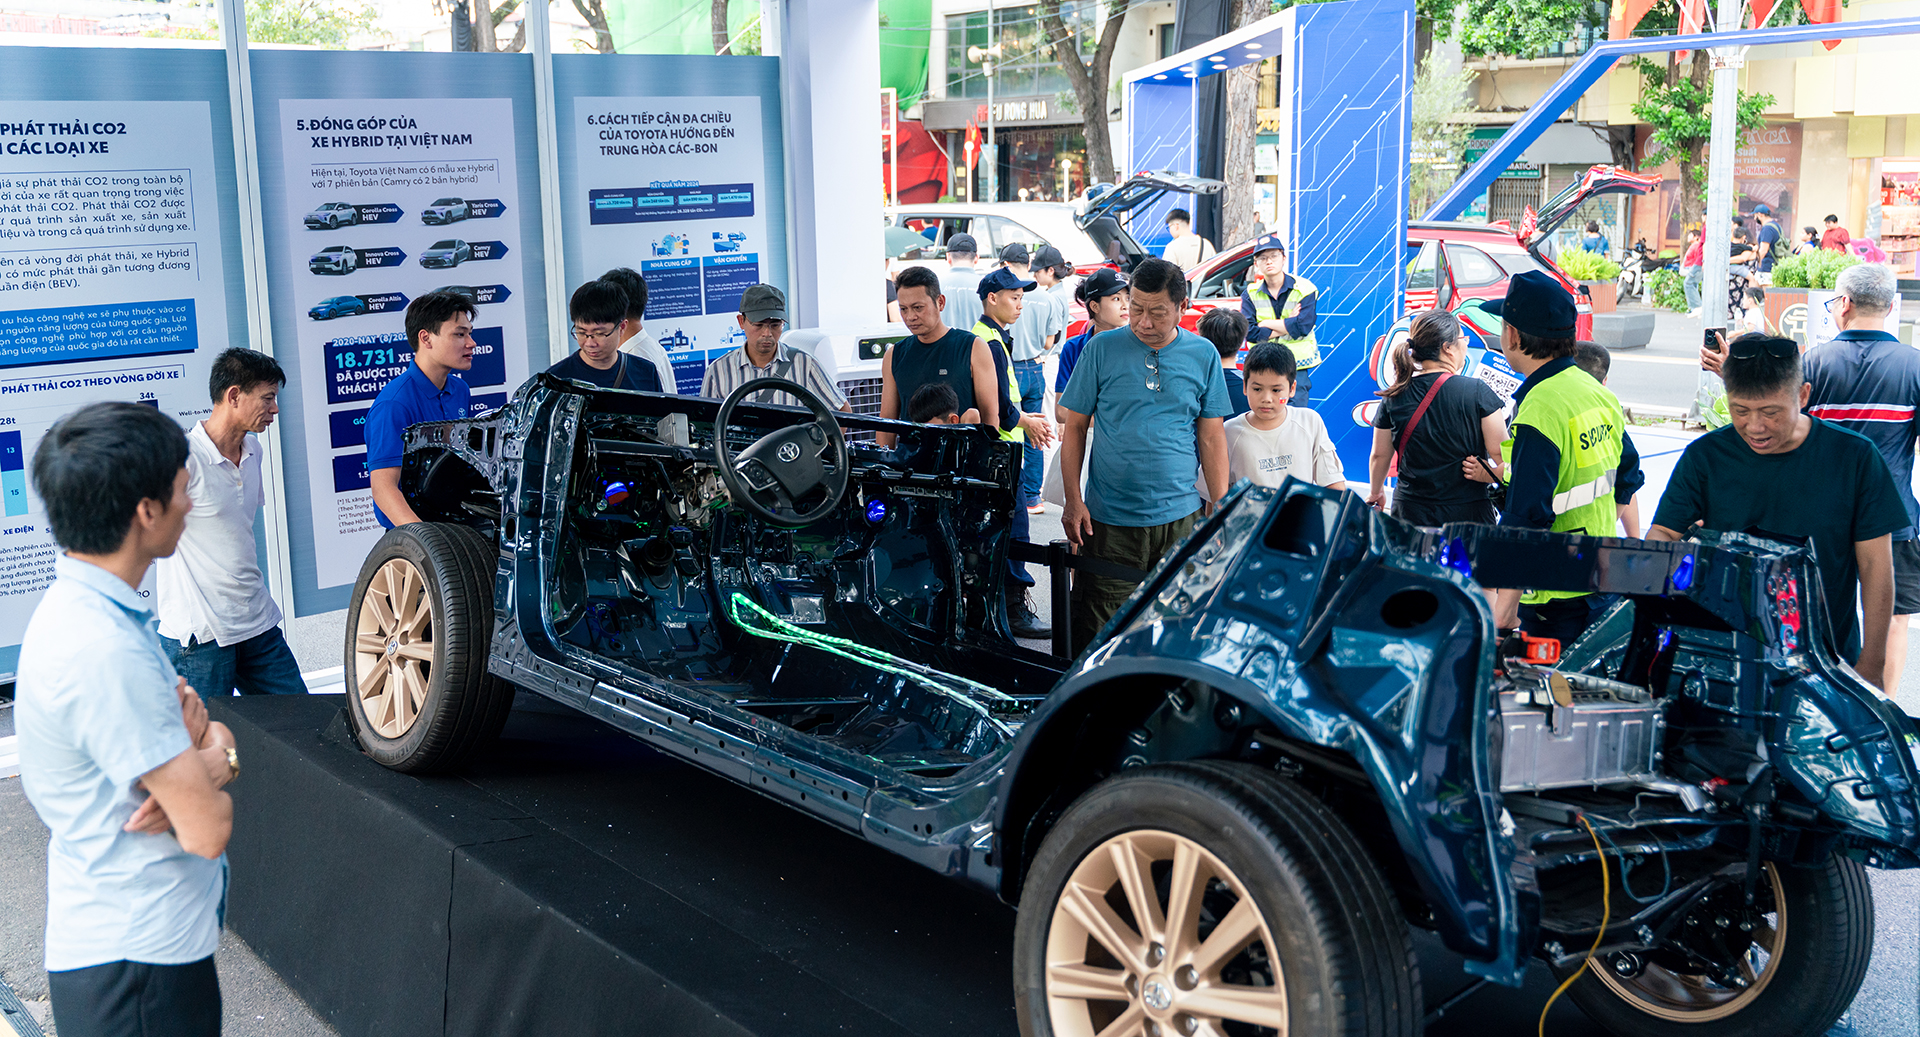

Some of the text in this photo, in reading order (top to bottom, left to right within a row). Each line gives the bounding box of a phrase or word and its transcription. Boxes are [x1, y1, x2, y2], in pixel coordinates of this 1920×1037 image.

[631, 110, 654, 124] TIẾP
[656, 112, 680, 126] CẬN
[683, 114, 698, 124] ĐA
[700, 110, 732, 123] CHIỀU
[993, 103, 1003, 121] U
[1004, 102, 1027, 120] RONG
[1029, 100, 1048, 120] HUA
[0, 118, 126, 135] PHÁT THẢI CO2
[357, 116, 386, 130] GÓP
[390, 114, 418, 130] CỦA
[600, 126, 734, 140] CỦA TOYOTA HƯỚNG ĐẾN
[7, 139, 109, 158] CÁC LOẠI XE
[311, 132, 472, 150] XE HYBRID TẠI VIỆT NAM
[600, 141, 718, 156] TRUNG HÒA CÁC-BON
[1466, 138, 1499, 150] TROPICA
[311, 169, 332, 178] Hiện
[334, 168, 347, 178] tại,
[350, 168, 377, 178] Toyota
[379, 166, 396, 176] Việt
[438, 164, 455, 173] mẫu
[468, 164, 494, 173] Hybrid
[16, 175, 183, 190] sự phát thải CO2 trong toàn bộ
[312, 180, 325, 188] với
[335, 180, 360, 189] phiên
[361, 178, 378, 186] bản
[380, 178, 411, 187] (Camry
[450, 175, 478, 185] hybrid)
[15, 191, 34, 200] của
[54, 190, 69, 198] rất
[72, 191, 99, 200] quan
[103, 190, 130, 199] trọng
[134, 189, 161, 198] trong
[165, 187, 184, 197] việc
[26, 203, 47, 212] thải
[51, 202, 78, 211] CO2.
[82, 201, 106, 210] Phát
[110, 200, 129, 209] thải
[134, 200, 156, 208] CO2
[160, 199, 185, 209] được
[0, 228, 20, 240] liệu
[23, 228, 35, 237] và
[38, 229, 67, 238] trong
[70, 226, 82, 235] cả
[84, 226, 104, 236] quá
[107, 224, 131, 234] trình
[134, 224, 146, 232] sử
[148, 223, 174, 233] dụng
[18, 256, 30, 265] cả
[35, 256, 61, 266] vòng
[66, 254, 83, 263] đời
[87, 252, 111, 264] phát
[157, 248, 189, 260] Hybrid
[332, 332, 408, 347] 2020-NAY (8/202
[335, 348, 394, 368] 18.731
[398, 353, 411, 362] XE
[2, 371, 179, 394] PHÁT THẢI CO2 THEO VÒNG ĐỜI XE
[336, 370, 353, 382] ĐÃ
[354, 368, 386, 381] ĐƯỢC
[337, 382, 377, 395] KHÁCH
[179, 408, 212, 416] Well-to-Wh
[353, 416, 366, 425] GÓ
[1259, 454, 1292, 469] ENJOY
